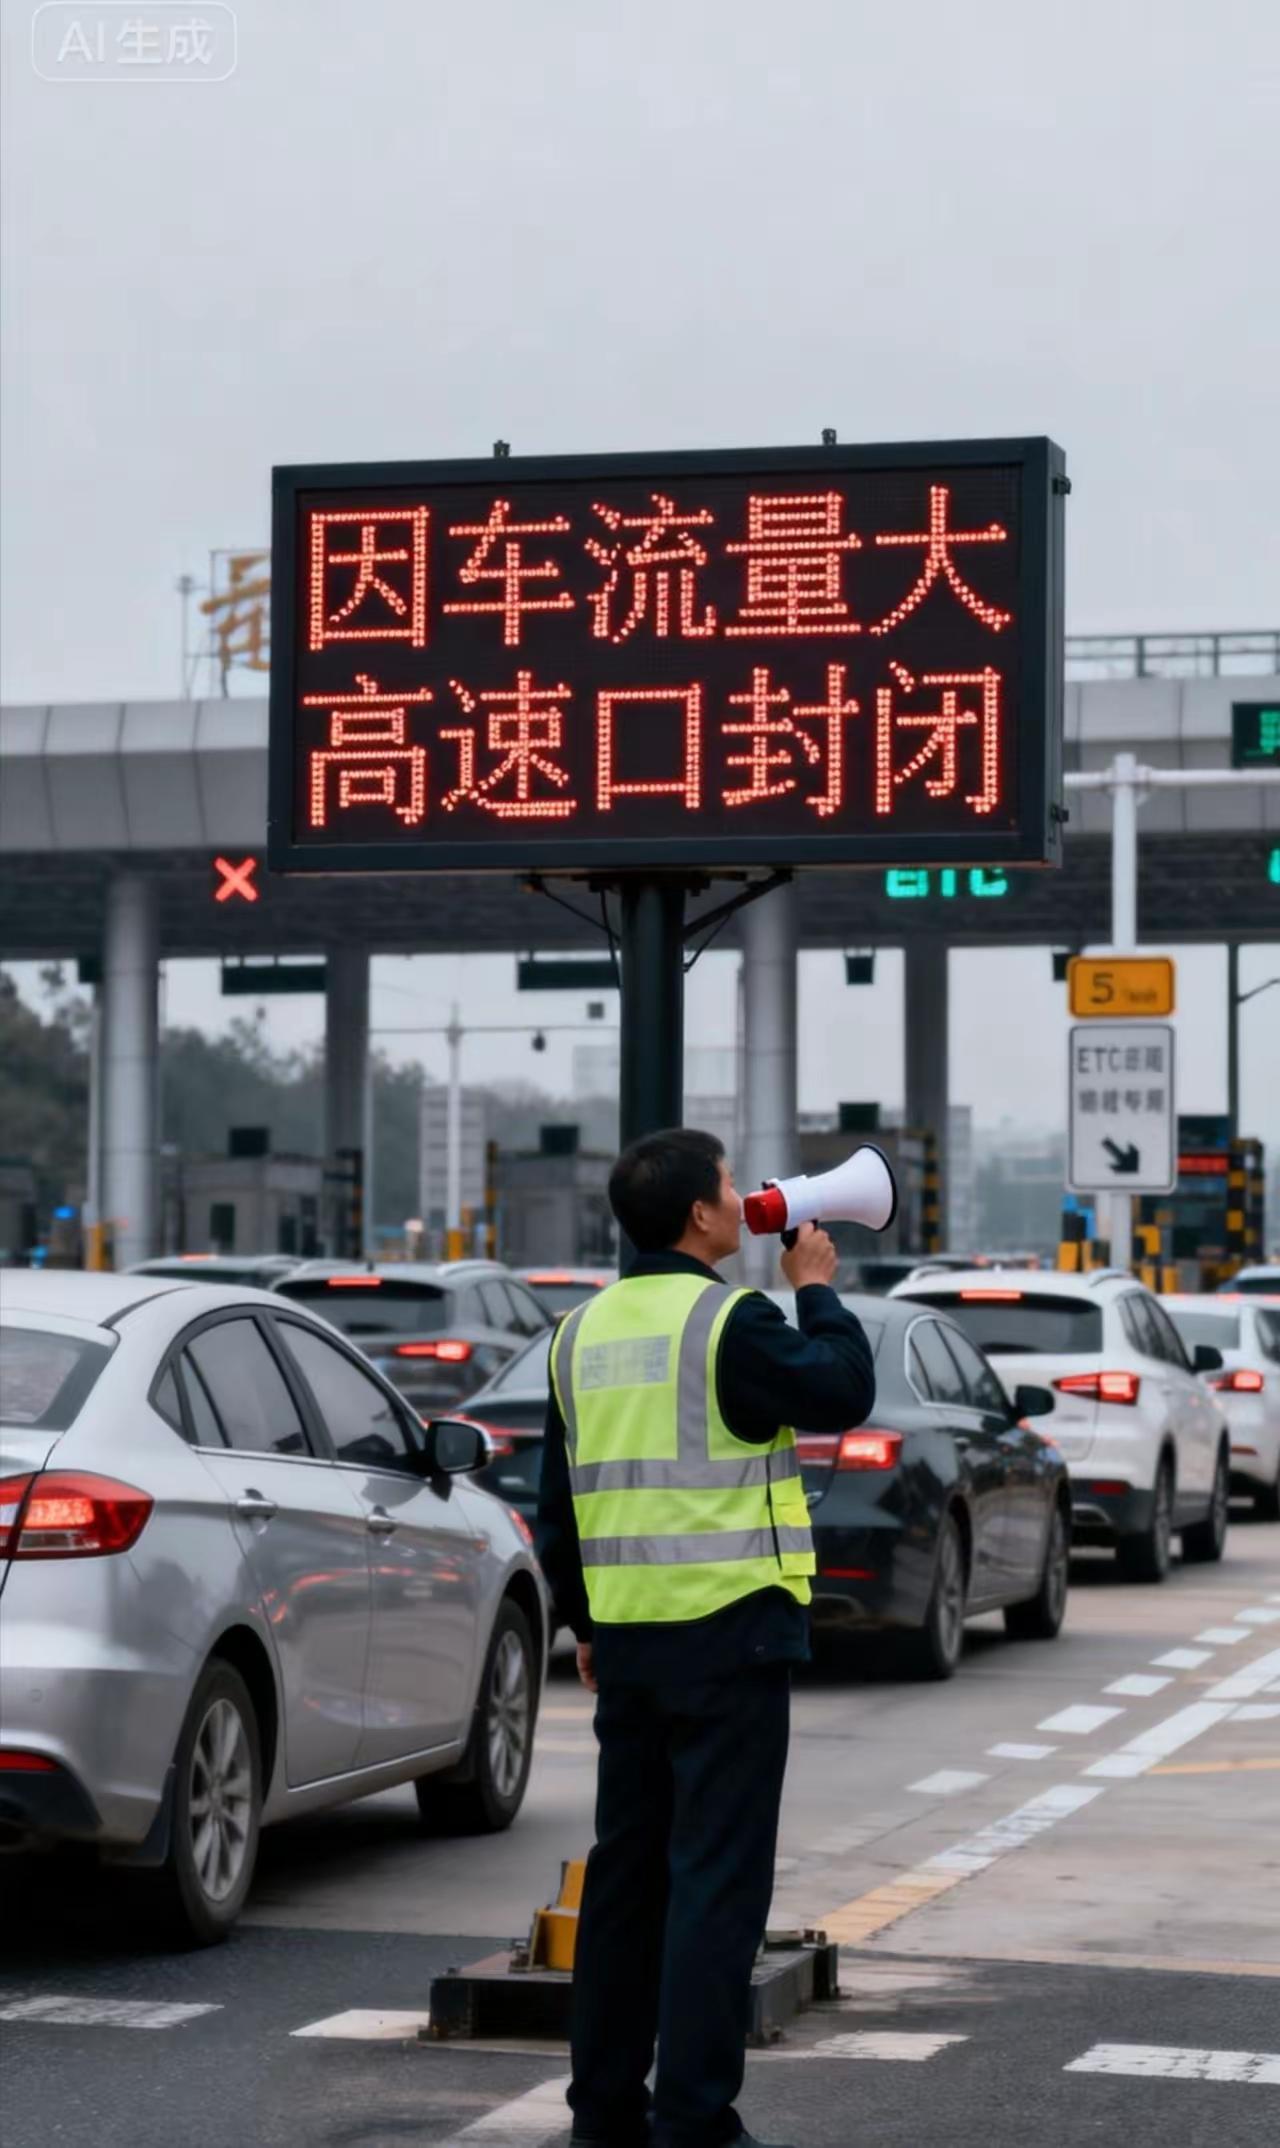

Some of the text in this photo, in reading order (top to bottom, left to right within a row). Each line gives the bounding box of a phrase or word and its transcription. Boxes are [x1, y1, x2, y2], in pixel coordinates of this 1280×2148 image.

[309, 484, 1011, 652] 因车流量大
[303, 660, 1001, 826] 高速口封闭
[1090, 972, 1114, 1003] 5
